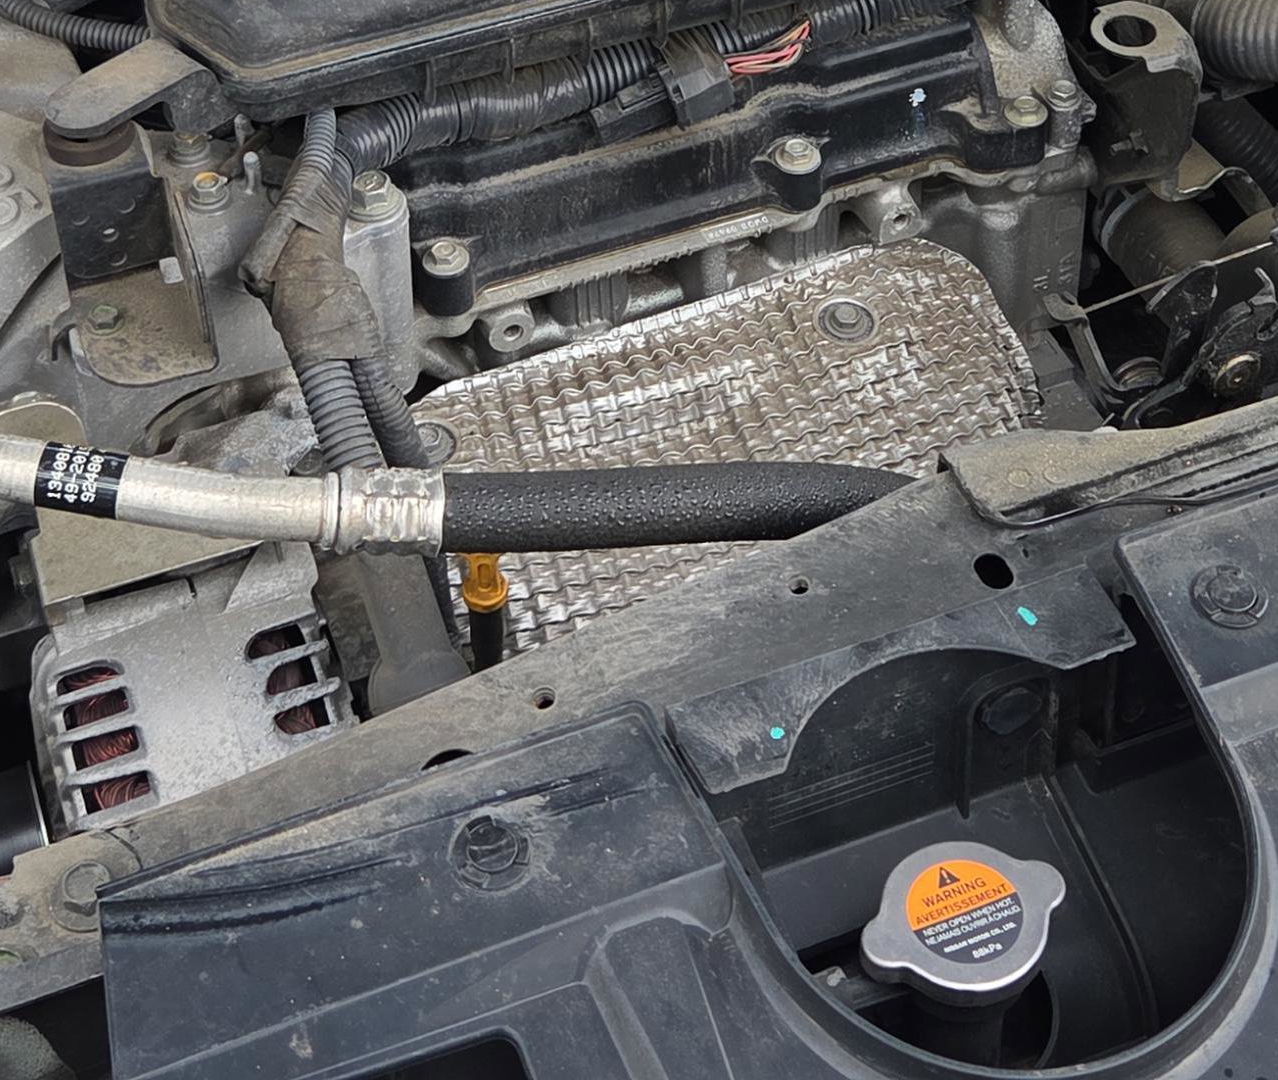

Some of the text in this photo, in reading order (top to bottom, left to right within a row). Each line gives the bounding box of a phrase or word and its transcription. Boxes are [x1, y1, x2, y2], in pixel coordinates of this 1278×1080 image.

[915, 882, 1009, 926] AVERTISSEMENT
[920, 876, 988, 908] WARNING
[922, 919, 950, 937] NEVER
[948, 913, 972, 928] OPEN
[970, 905, 996, 920] WHEN
[925, 936, 938, 946] NE
[935, 928, 962, 944] JAMAIS
[960, 917, 989, 934] OUVRIR
